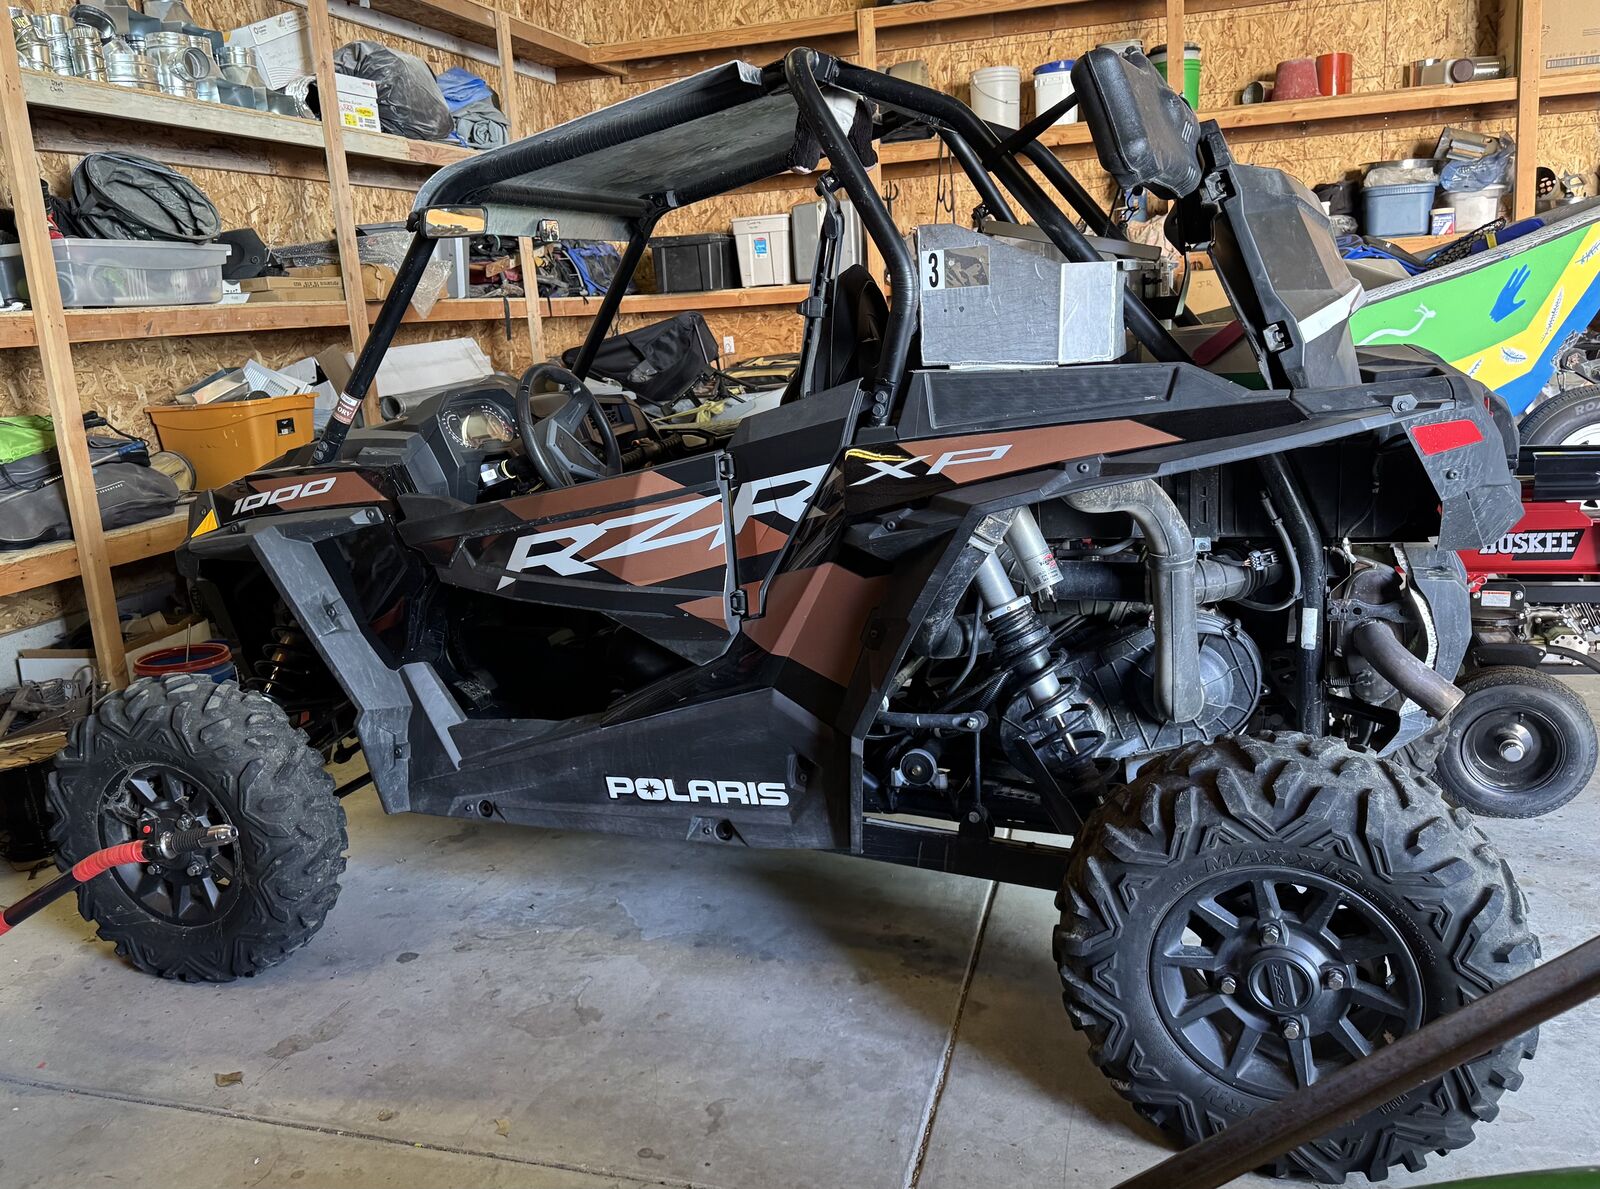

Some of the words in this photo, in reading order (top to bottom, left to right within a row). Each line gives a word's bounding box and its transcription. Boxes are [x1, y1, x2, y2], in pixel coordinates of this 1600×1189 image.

[928, 252, 940, 288] 3
[337, 406, 353, 417] ORV
[849, 444, 1013, 487] XP
[232, 477, 337, 515] 1000
[496, 463, 831, 591] RZR
[605, 776, 790, 807] POLARIS
